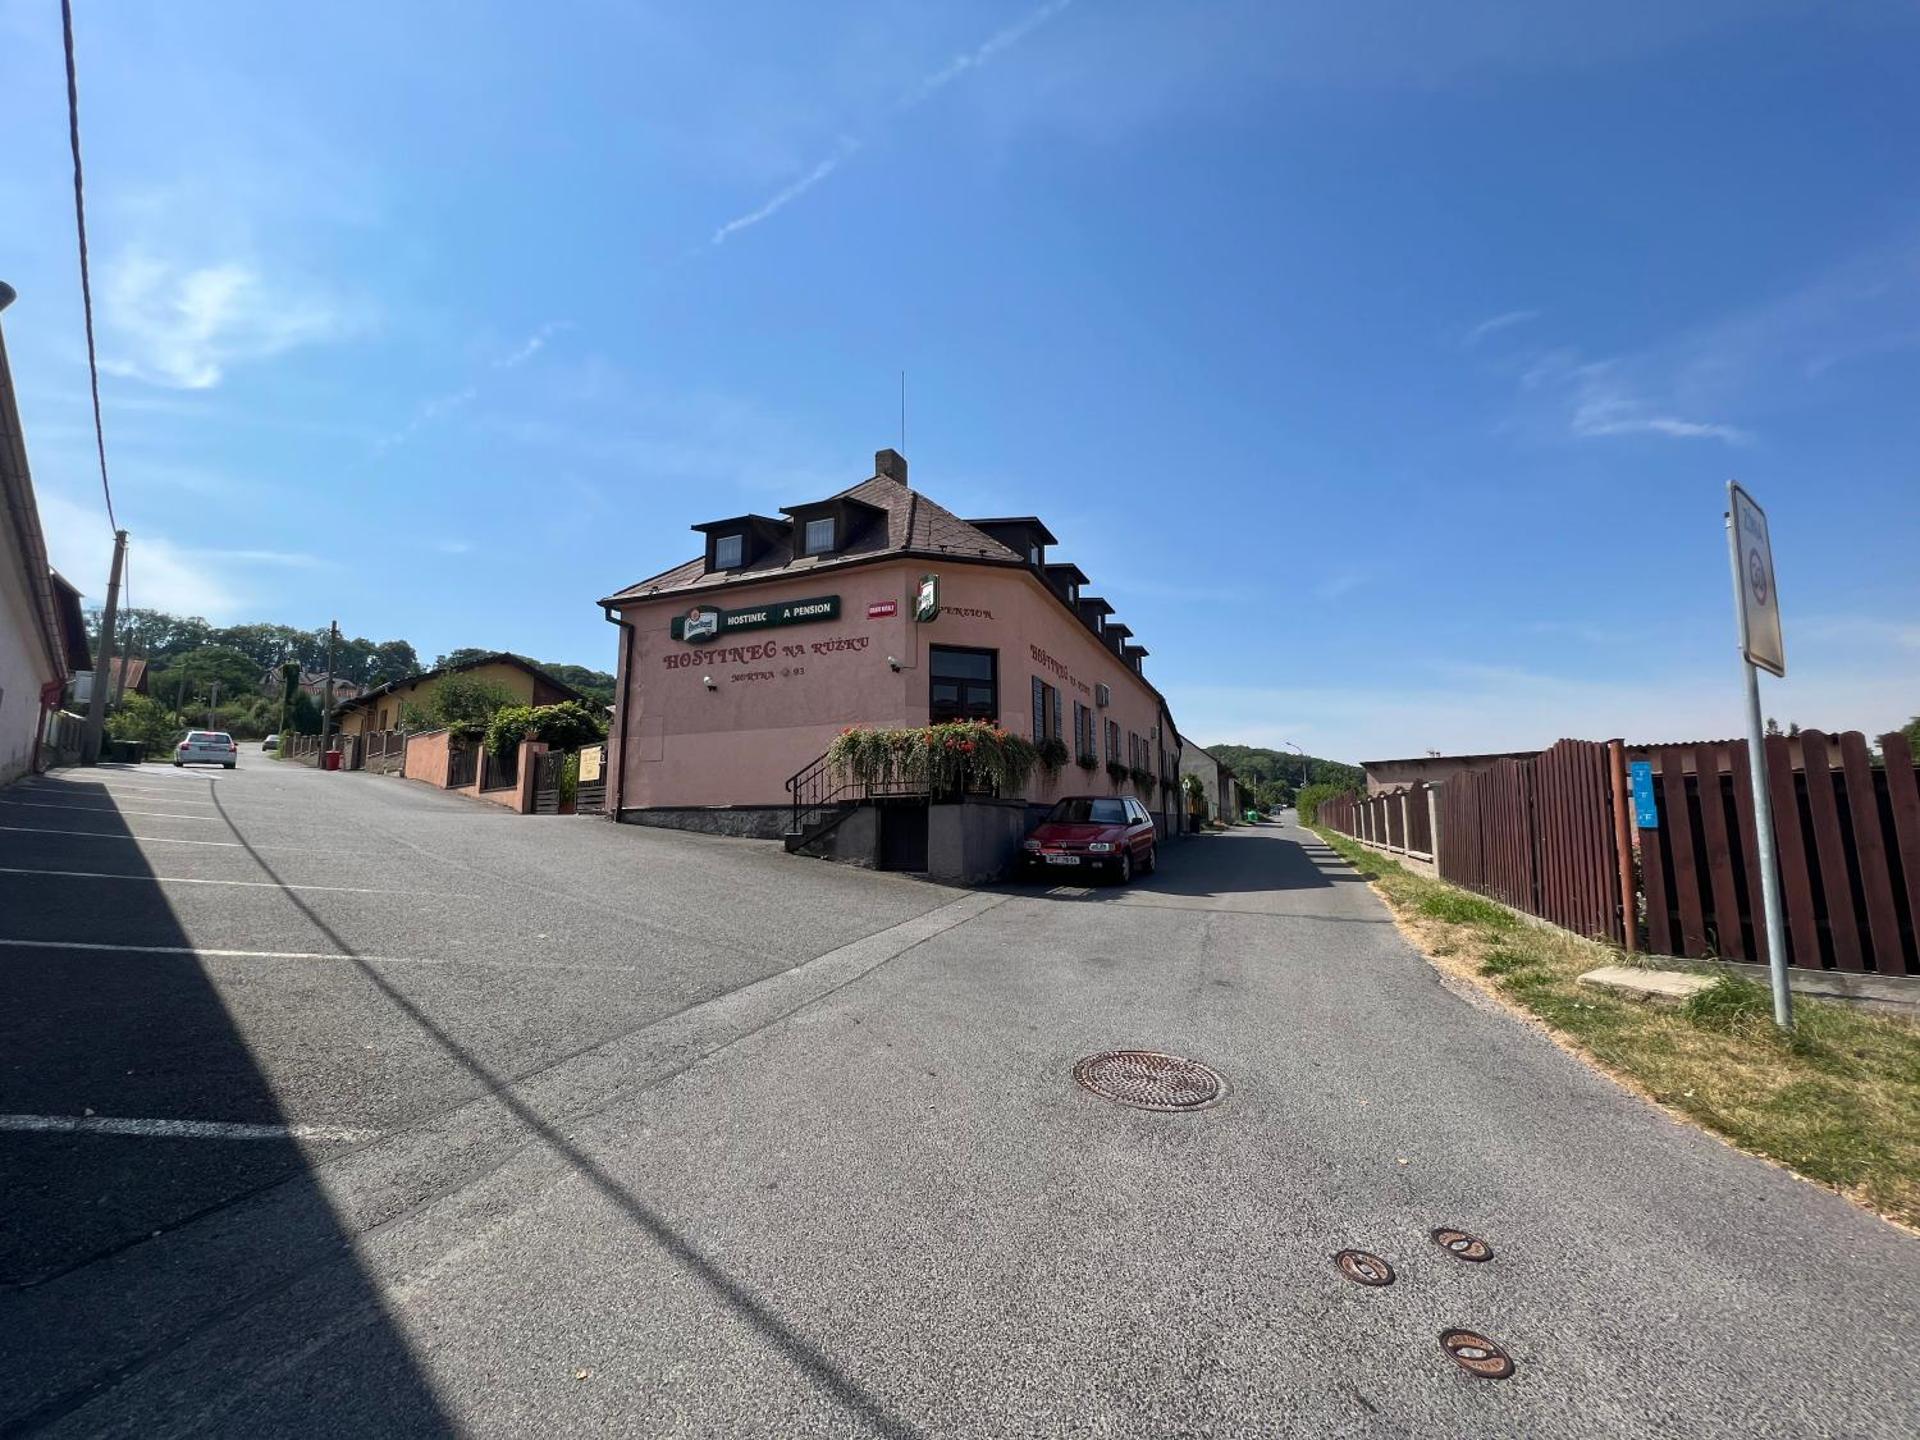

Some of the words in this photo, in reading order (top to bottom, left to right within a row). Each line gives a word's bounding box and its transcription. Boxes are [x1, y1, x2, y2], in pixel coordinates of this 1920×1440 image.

[727, 612, 767, 625] HOSTINEC
[784, 609, 791, 618] A
[793, 603, 831, 617] PENSION
[664, 641, 777, 670] HOSTINEC
[782, 644, 806, 658] NA
